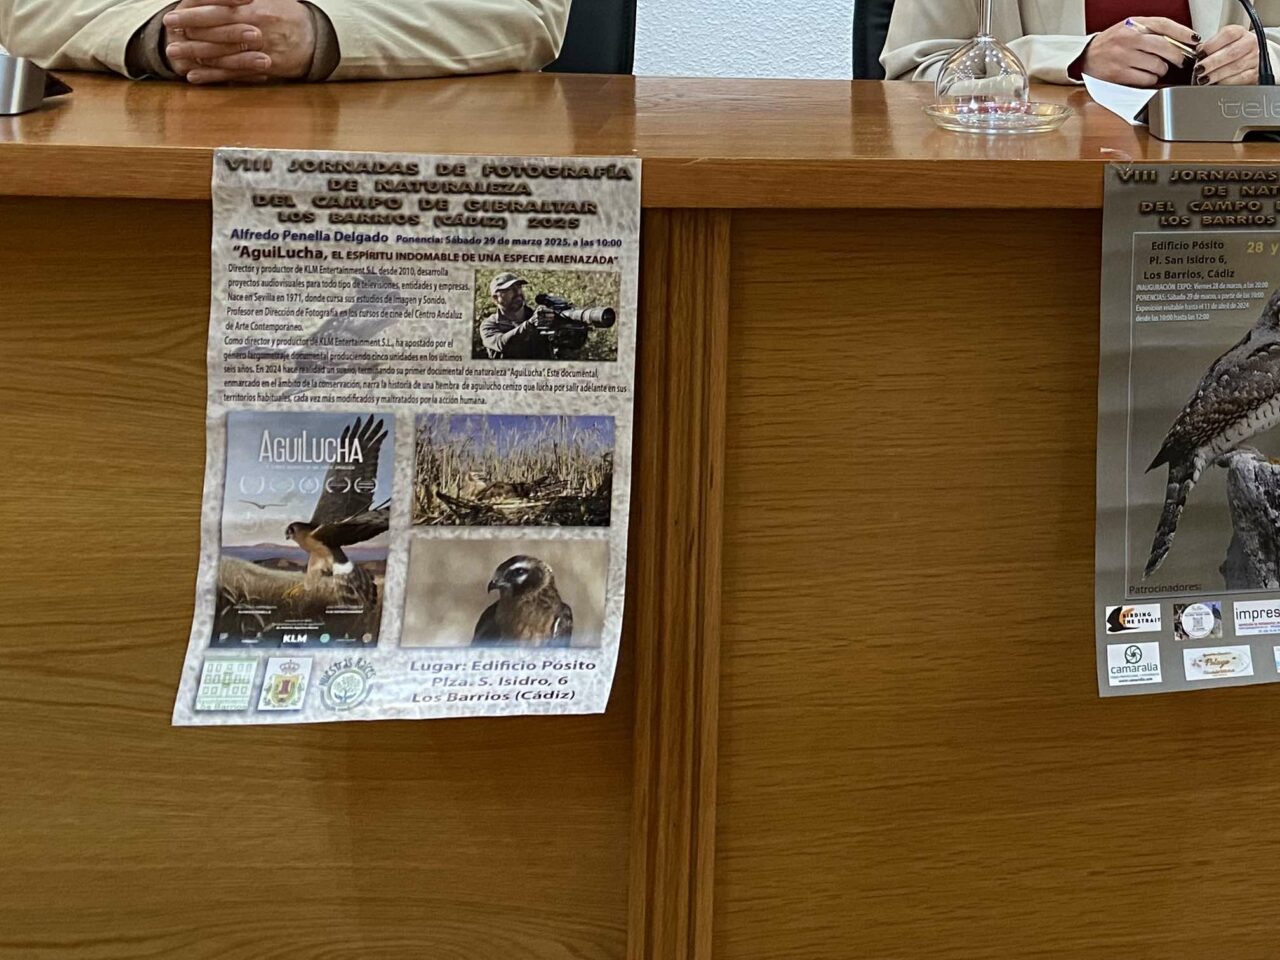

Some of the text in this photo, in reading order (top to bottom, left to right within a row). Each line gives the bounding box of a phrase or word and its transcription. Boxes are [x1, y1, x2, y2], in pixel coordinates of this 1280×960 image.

[222, 158, 633, 180] VIII JORNADAS DE FOTOGRAFÍA
[1118, 170, 1159, 182] VIII
[1167, 170, 1280, 182] JORNADAS
[328, 178, 532, 196] DE NATURALEZA
[1202, 185, 1229, 196] DE
[252, 194, 598, 215] DEL CAMPO DE GIBRALTAR
[1138, 201, 1176, 212] DEL
[1186, 200, 1263, 212] CAMPO
[276, 211, 580, 230] LOS BARRIOS (CÁDIZ) 2025
[1158, 215, 1192, 226] LOS
[1199, 214, 1278, 226] BARRIOS
[230, 228, 389, 244] Alfredo Penella Delgado
[1150, 241, 1224, 250] Edificio Pósito
[1246, 241, 1263, 253] 28
[1270, 243, 1279, 255] y
[330, 250, 619, 265] EL ESPÍRITU INDOMABLE DE UNA ESPECIE AMENAZADA”
[1149, 255, 1227, 265] Pl. San Isidro 6,
[1143, 269, 1235, 280] Los Barrios, Cádiz
[282, 634, 308, 644] KLM
[410, 660, 597, 674] Lugar: Edificio Pósito
[1110, 662, 1158, 674] camaralia
[431, 675, 568, 687] Plza. S. Isidro, 6
[411, 690, 577, 703] Los Barrios (Cádiz)
